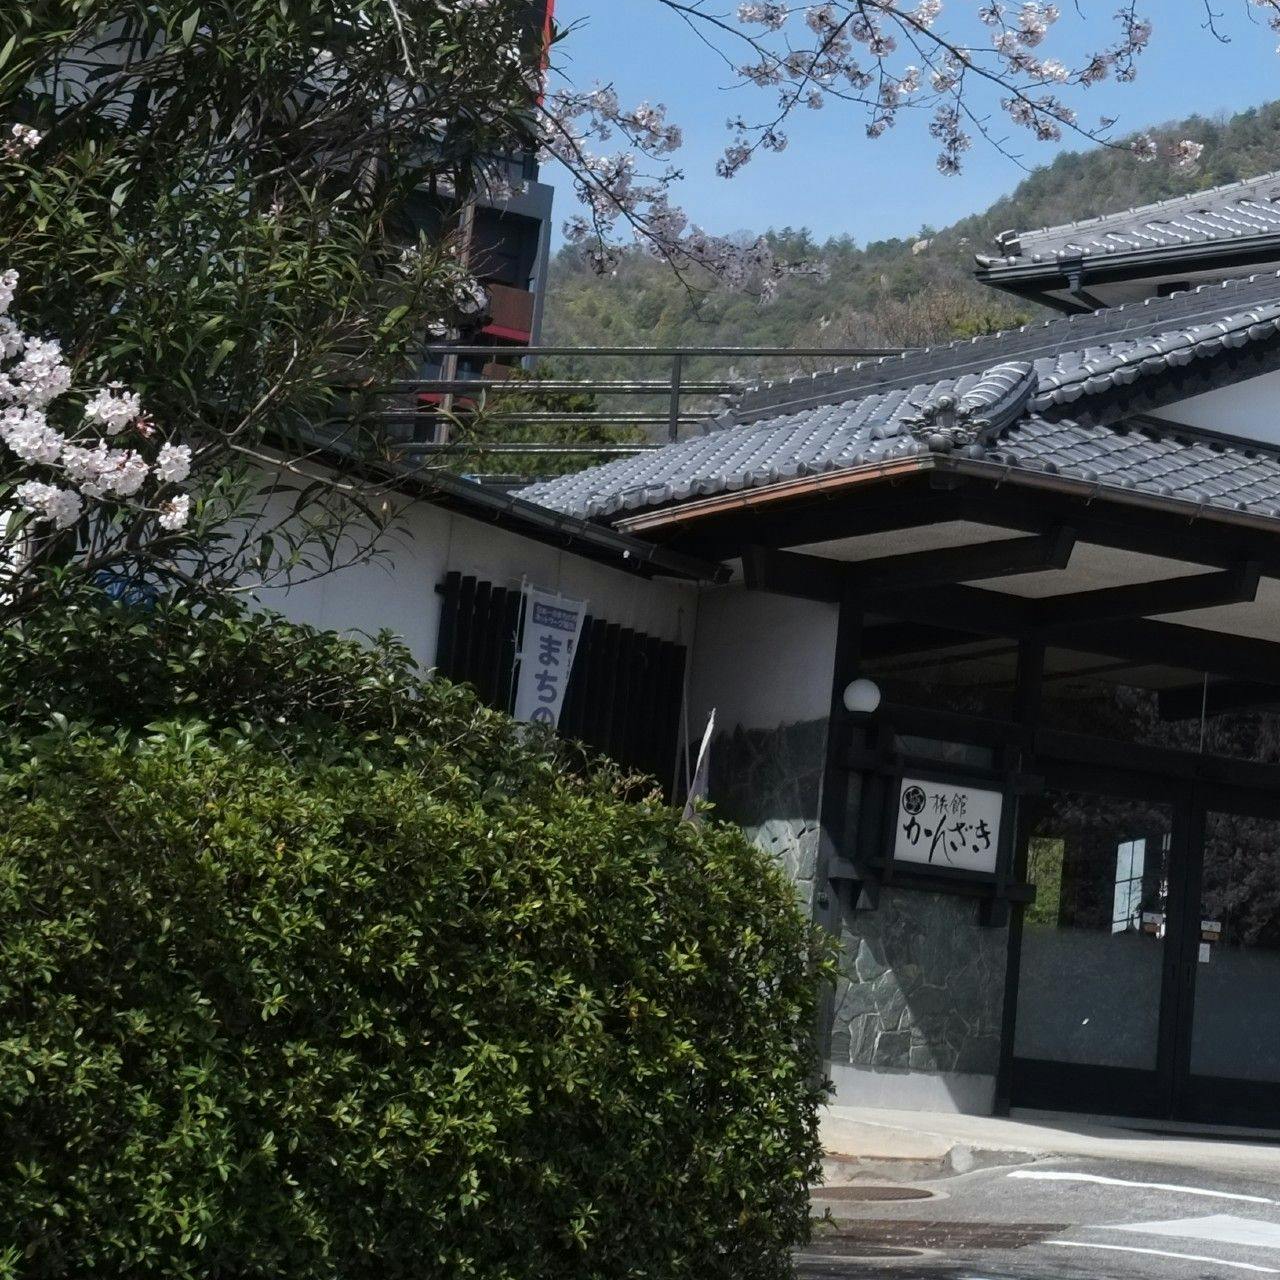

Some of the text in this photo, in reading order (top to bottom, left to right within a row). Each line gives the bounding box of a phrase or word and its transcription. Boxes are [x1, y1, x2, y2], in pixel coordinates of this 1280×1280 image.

[929, 793, 968, 817] 旅館
[903, 814, 991, 864] かんざき
